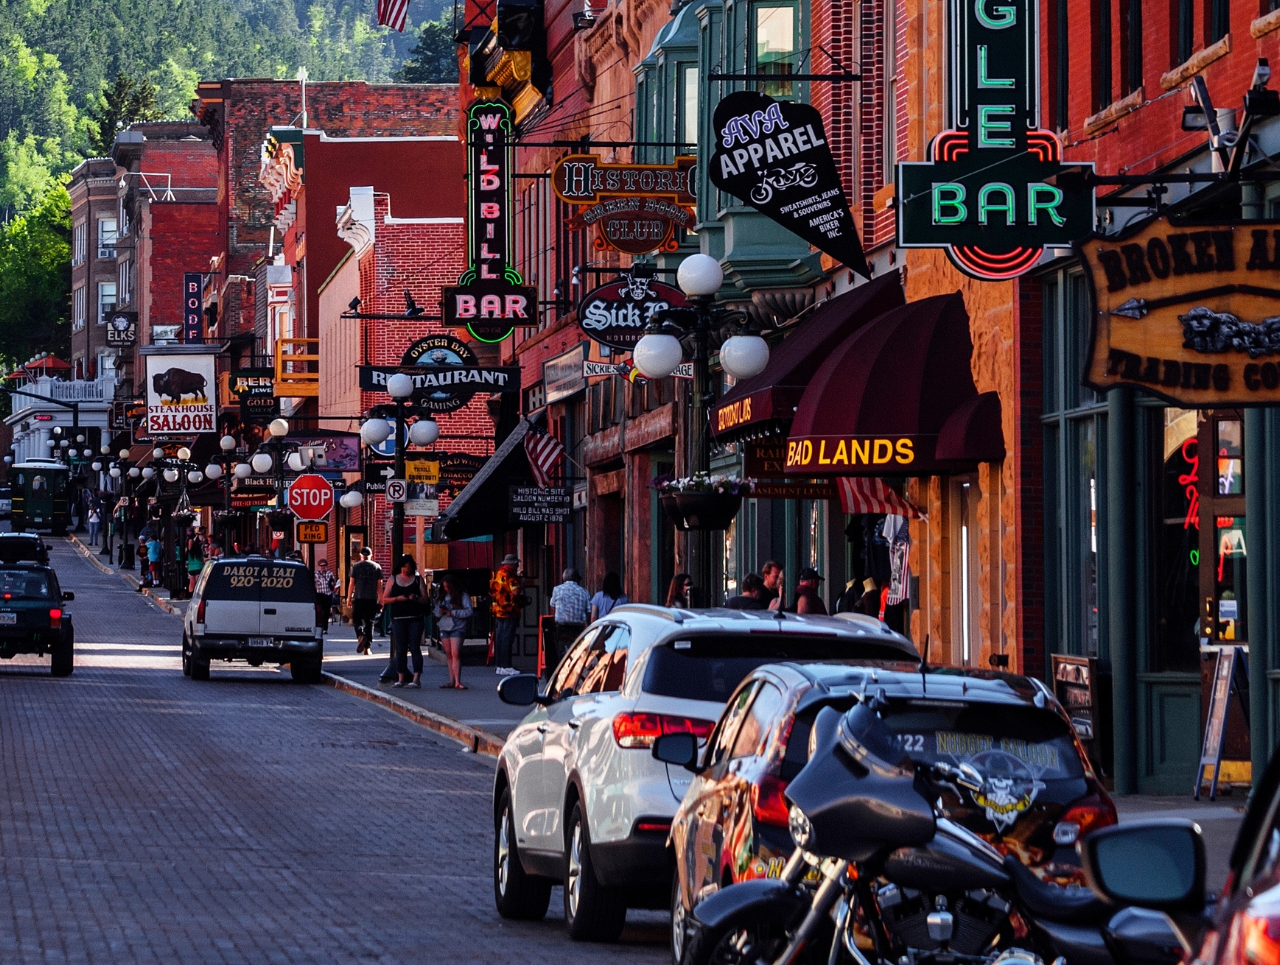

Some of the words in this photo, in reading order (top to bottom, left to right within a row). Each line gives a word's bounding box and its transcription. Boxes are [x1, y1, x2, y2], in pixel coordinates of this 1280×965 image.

[721, 103, 790, 148] AVA
[478, 113, 501, 191] WILD
[720, 124, 825, 179] APPAREL
[821, 188, 840, 200] JEANS
[793, 210, 799, 219] &
[799, 200, 832, 217] SOUVENIRS
[930, 182, 1068, 227] BAR
[583, 197, 641, 225] GREEN
[644, 197, 690, 226] DOOR
[809, 208, 845, 228] AMERICA'S
[607, 219, 664, 241] CLUB
[819, 220, 840, 233] BIKER
[481, 202, 500, 279] BILL
[827, 228, 843, 240] INC.
[1098, 230, 1236, 294] BROKEN
[1246, 228, 1280, 271] A
[455, 294, 529, 319] BAR
[582, 299, 642, 331] Sick
[107, 329, 135, 341] ELKS
[410, 338, 448, 359] OYSTER
[451, 341, 471, 359] BAY
[1107, 347, 1231, 393] TRADING
[236, 376, 275, 387] BER
[148, 404, 215, 414] STEAKHOUSE
[246, 399, 275, 407] GOLD
[420, 398, 461, 411] GAMING
[149, 414, 215, 432] SALOON
[786, 439, 813, 467] BAD
[818, 437, 916, 466] LANDS
[244, 478, 265, 486] Black
[366, 482, 386, 491] Public
[291, 488, 331, 506] STOP
[550, 488, 565, 496] SITE
[803, 487, 835, 496] LEVEL
[537, 495, 563, 503] NUMBER
[541, 507, 554, 515] WAS
[519, 514, 543, 522] AUGUST
[304, 524, 320, 533] PED
[303, 532, 322, 541] XING
[272, 567, 297, 578] TAXI
[230, 576, 294, 588] 920-2020
[936, 730, 994, 756] NUGGET
